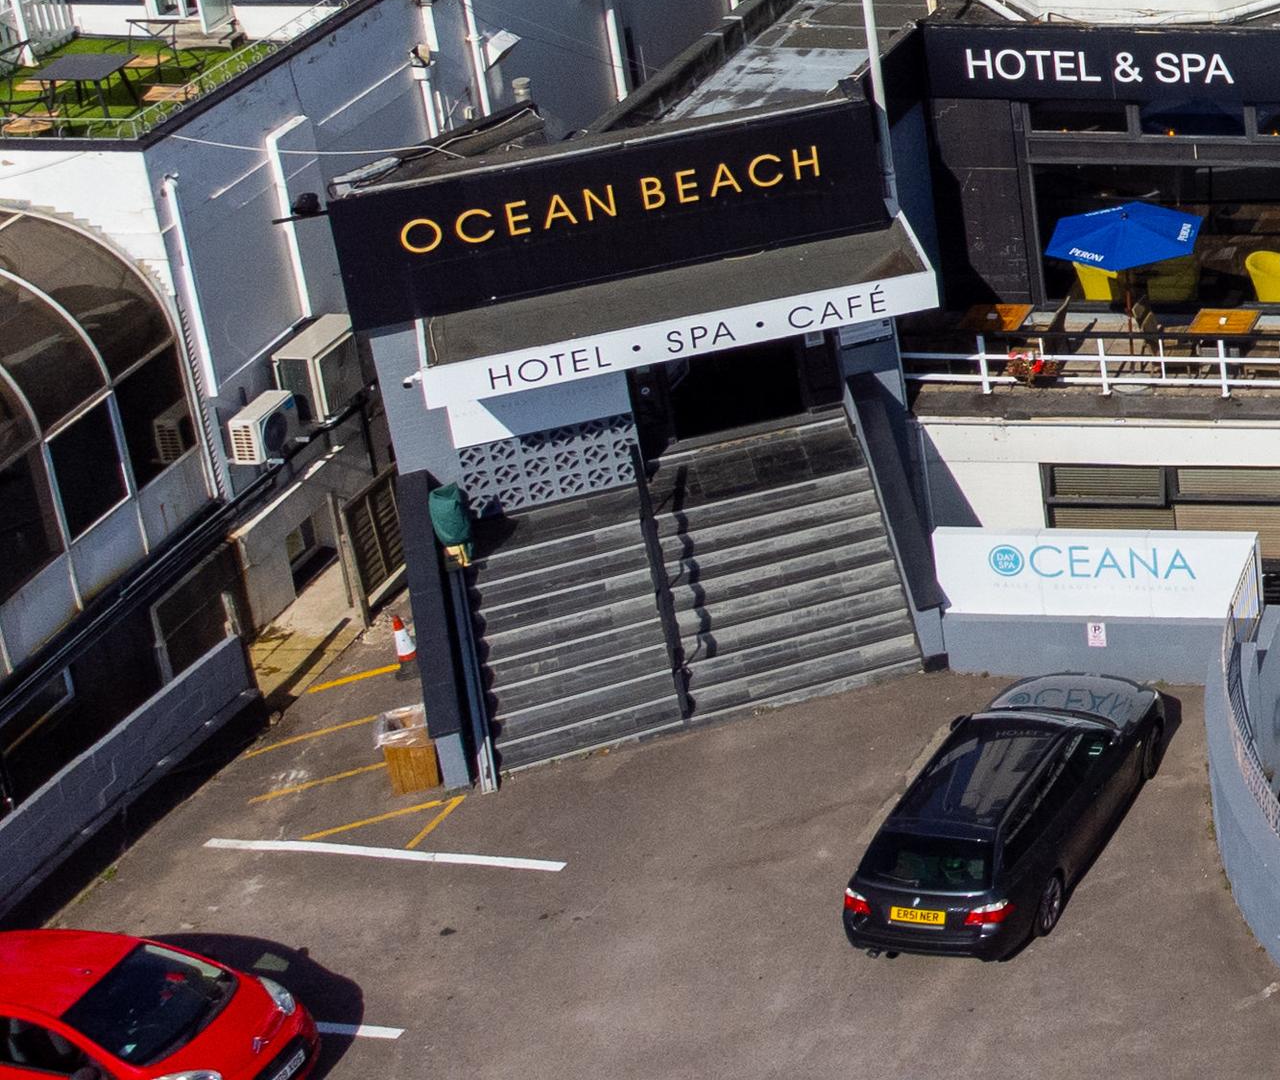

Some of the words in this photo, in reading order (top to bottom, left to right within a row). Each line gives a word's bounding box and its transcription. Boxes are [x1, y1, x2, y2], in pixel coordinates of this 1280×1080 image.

[965, 48, 1102, 82] HOTEL
[1114, 51, 1143, 83] &
[1155, 52, 1235, 84] SPA
[400, 184, 617, 253] OCEAN
[639, 146, 822, 210] BEACH
[1068, 247, 1105, 263] PERONI
[487, 345, 612, 390] HOTEL
[666, 321, 736, 354] SPA
[787, 284, 887, 330] CAFÉ
[988, 543, 1197, 580] OCEANA
[996, 552, 1016, 562] DAY
[998, 560, 1016, 569] SPA
[919, 911, 940, 922] NER
